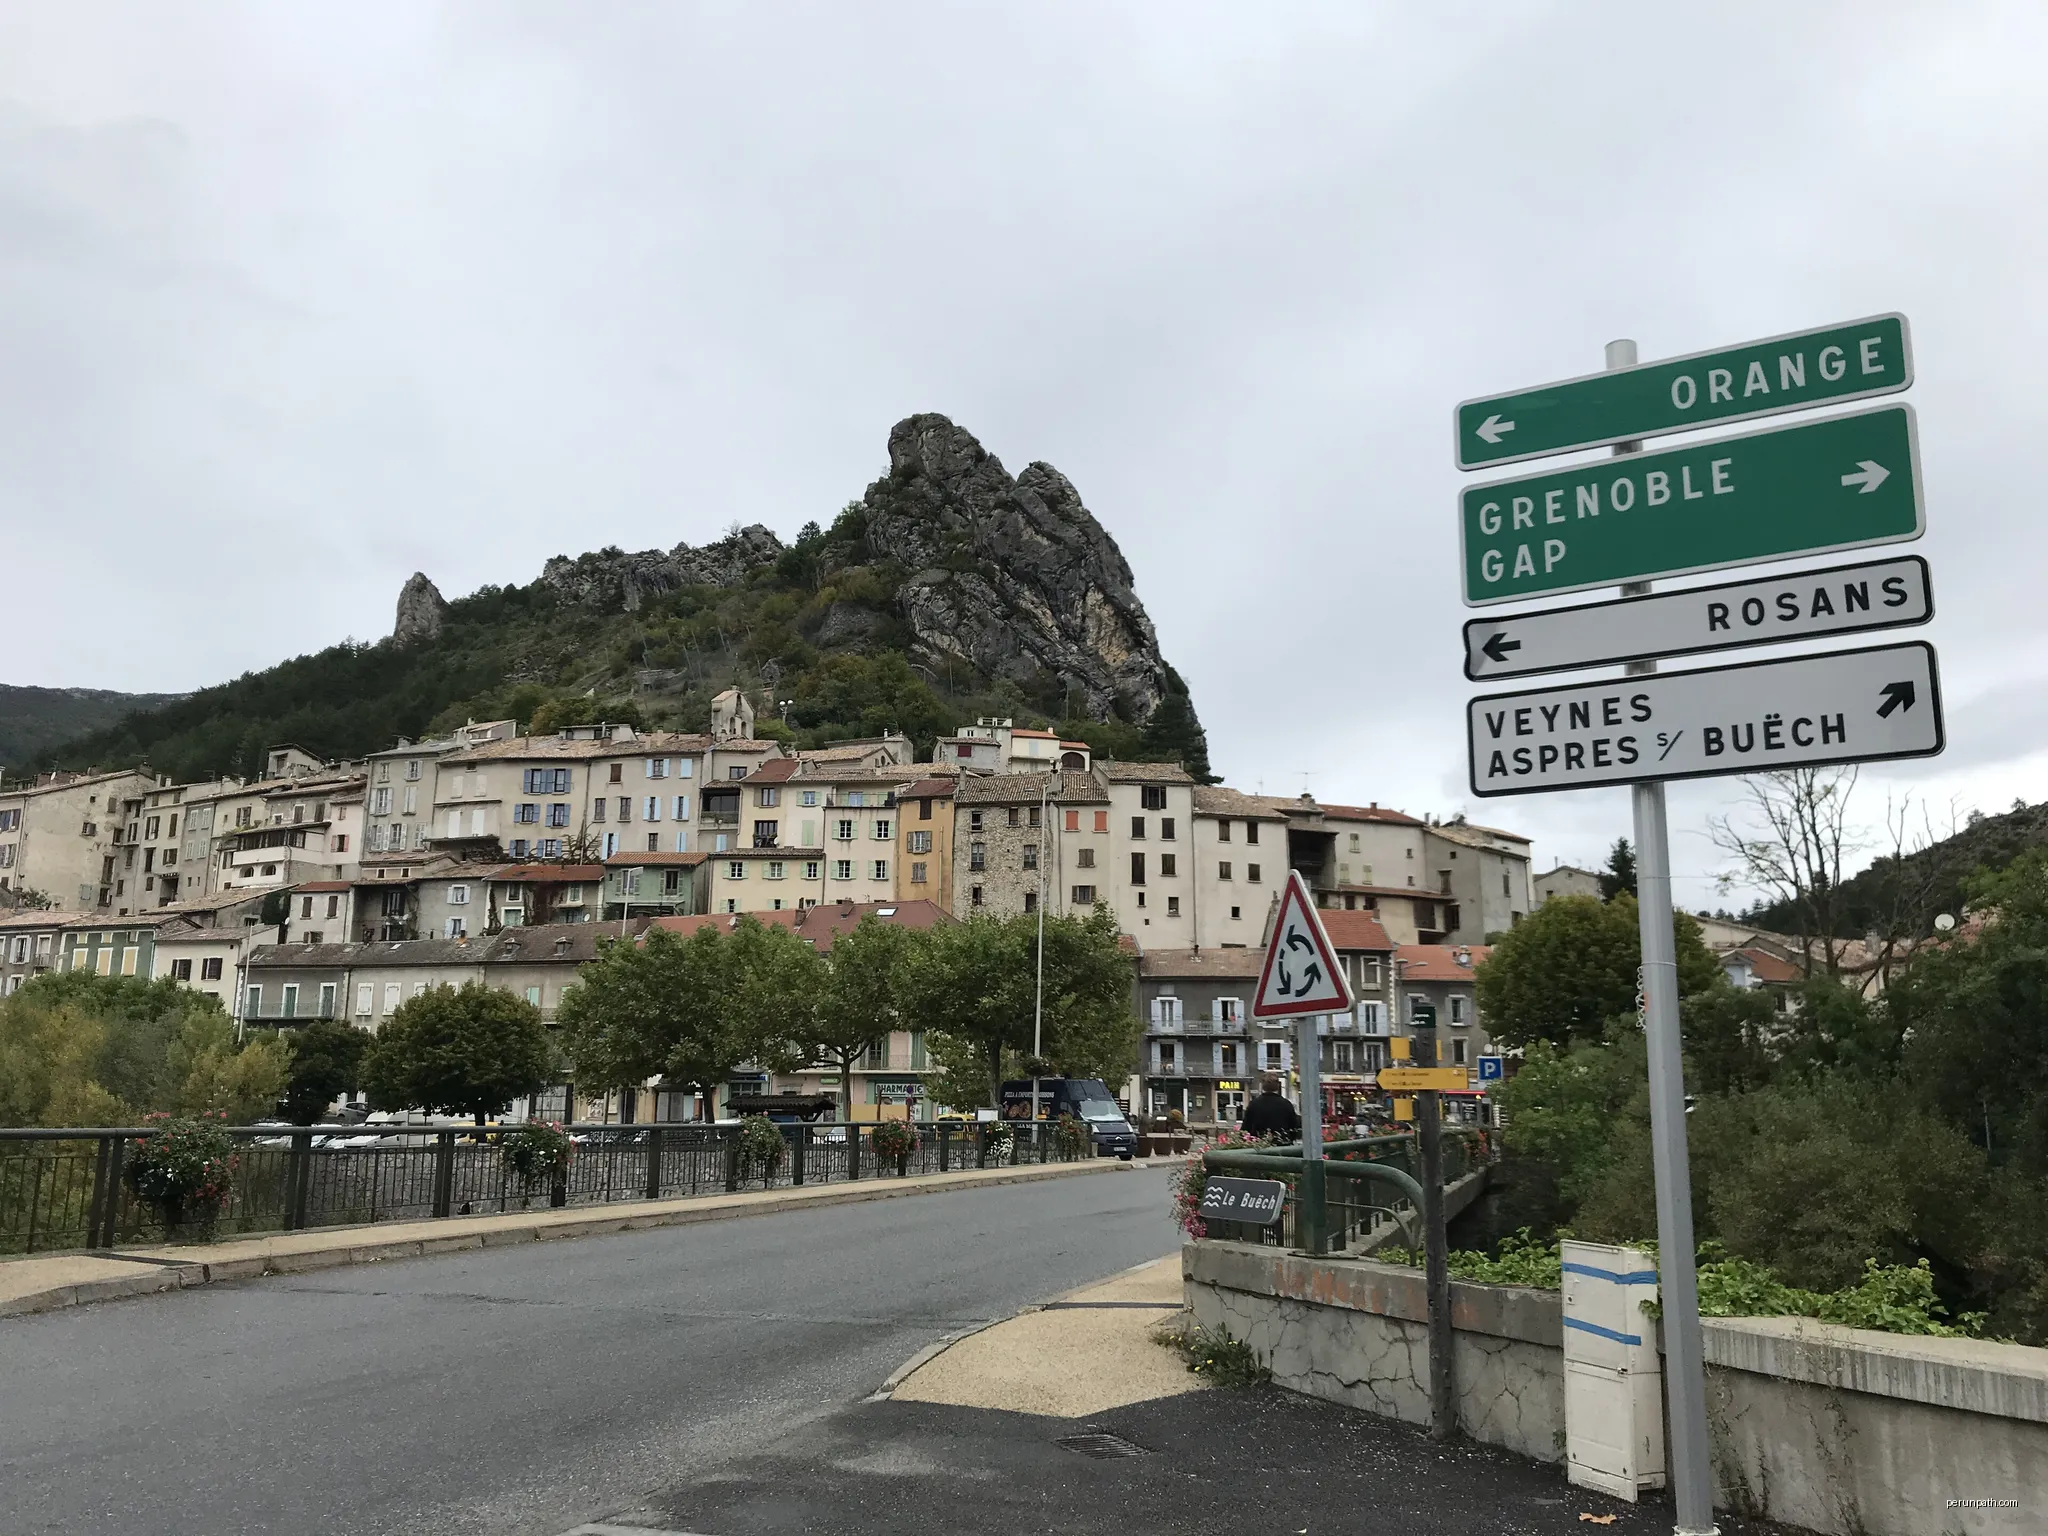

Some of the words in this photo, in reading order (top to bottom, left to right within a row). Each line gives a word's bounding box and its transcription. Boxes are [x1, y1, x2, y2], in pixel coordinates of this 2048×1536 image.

[1671, 337, 1885, 409] ORANGE
[1479, 458, 1735, 535] GRENOBLE
[1481, 539, 1566, 582] GAP
[1707, 577, 1908, 632] ROSANS
[1485, 694, 1652, 739] VEYNES
[1488, 736, 1640, 778] ASPRES
[1703, 713, 1846, 756] BUËCH
[876, 1084, 924, 1094] PHARMAIE
[1219, 1080, 1240, 1089] PAIN
[1484, 1062, 1496, 1077] P
[1222, 1191, 1236, 1206] Le
[1240, 1193, 1276, 1210] Buëch
